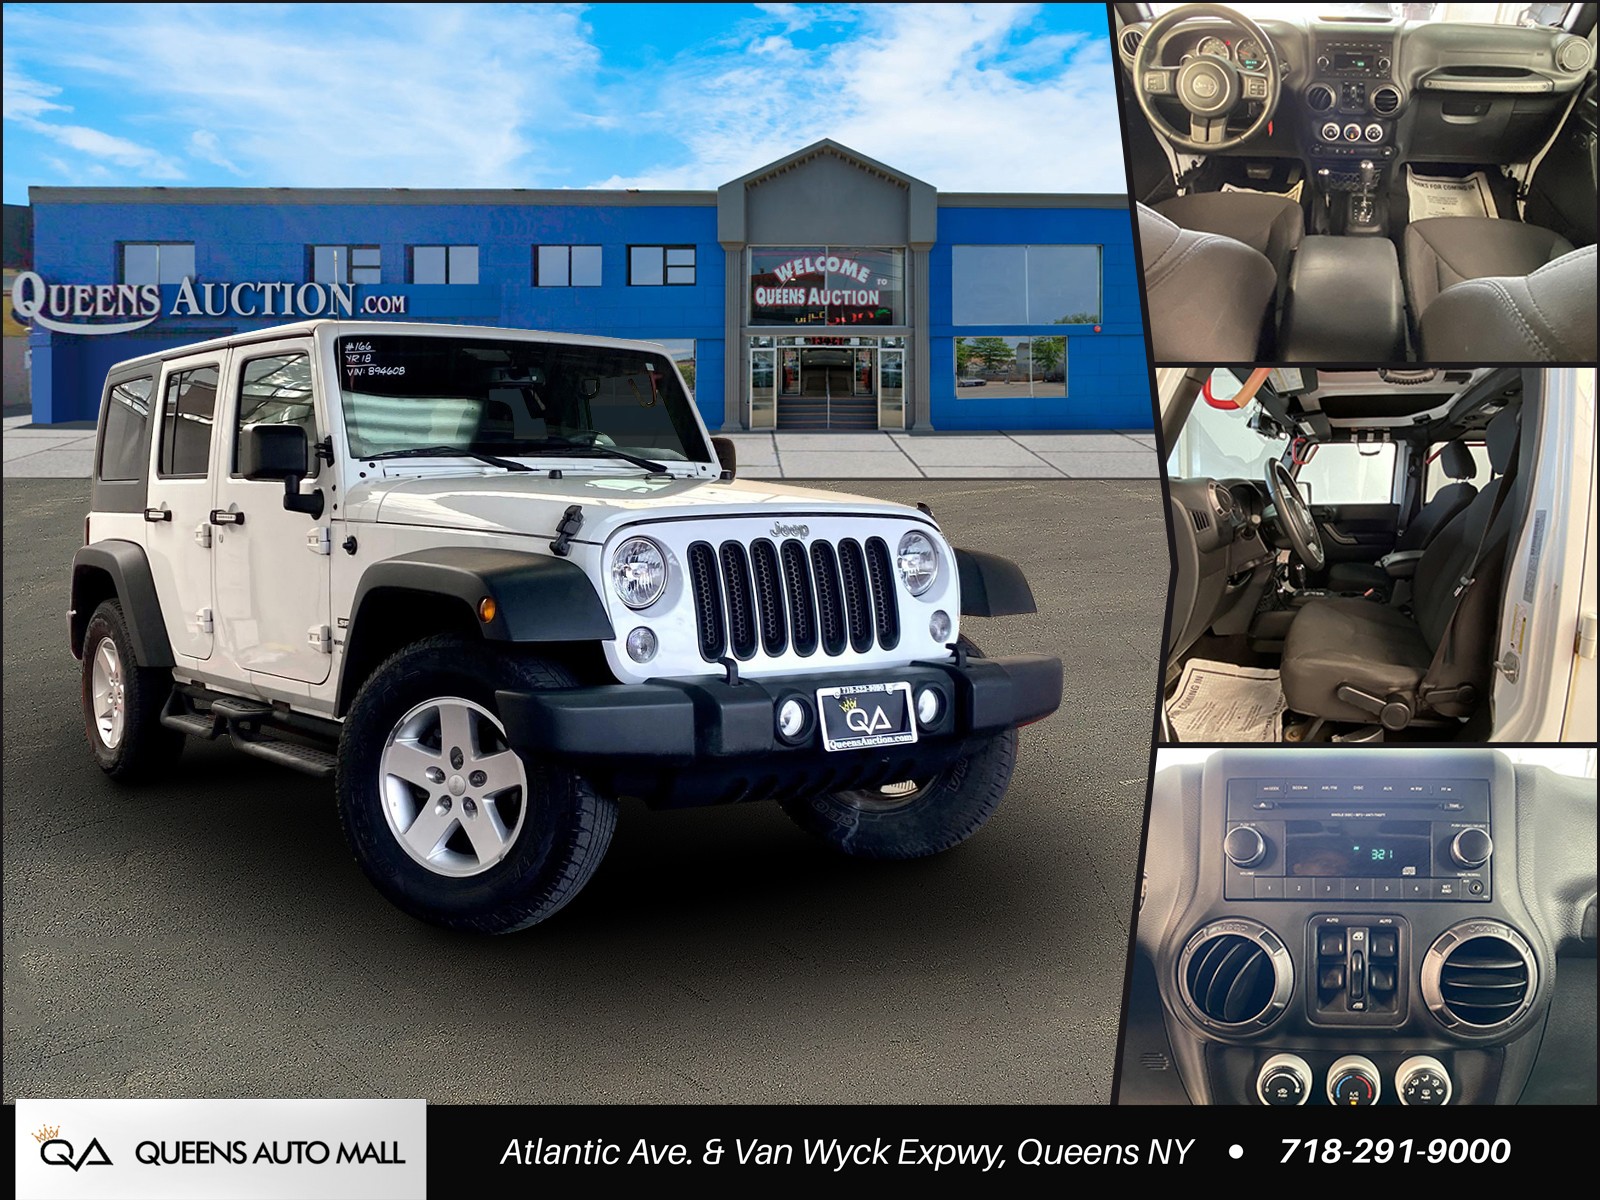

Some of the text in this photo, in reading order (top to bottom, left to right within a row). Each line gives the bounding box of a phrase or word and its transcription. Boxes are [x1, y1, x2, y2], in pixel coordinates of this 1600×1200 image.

[774, 256, 870, 283] WELCOME
[877, 278, 887, 286] TO
[12, 271, 160, 335] QUEENS
[170, 276, 355, 316] AUCTION
[755, 287, 879, 306] QUEENS AUCTION
[345, 342, 371, 351] #166
[346, 354, 372, 362] YR 18
[347, 366, 405, 376] VIN: 894608
[770, 521, 809, 540] Jeep
[846, 705, 892, 735] QA
[829, 734, 912, 750] QueensAuction.com
